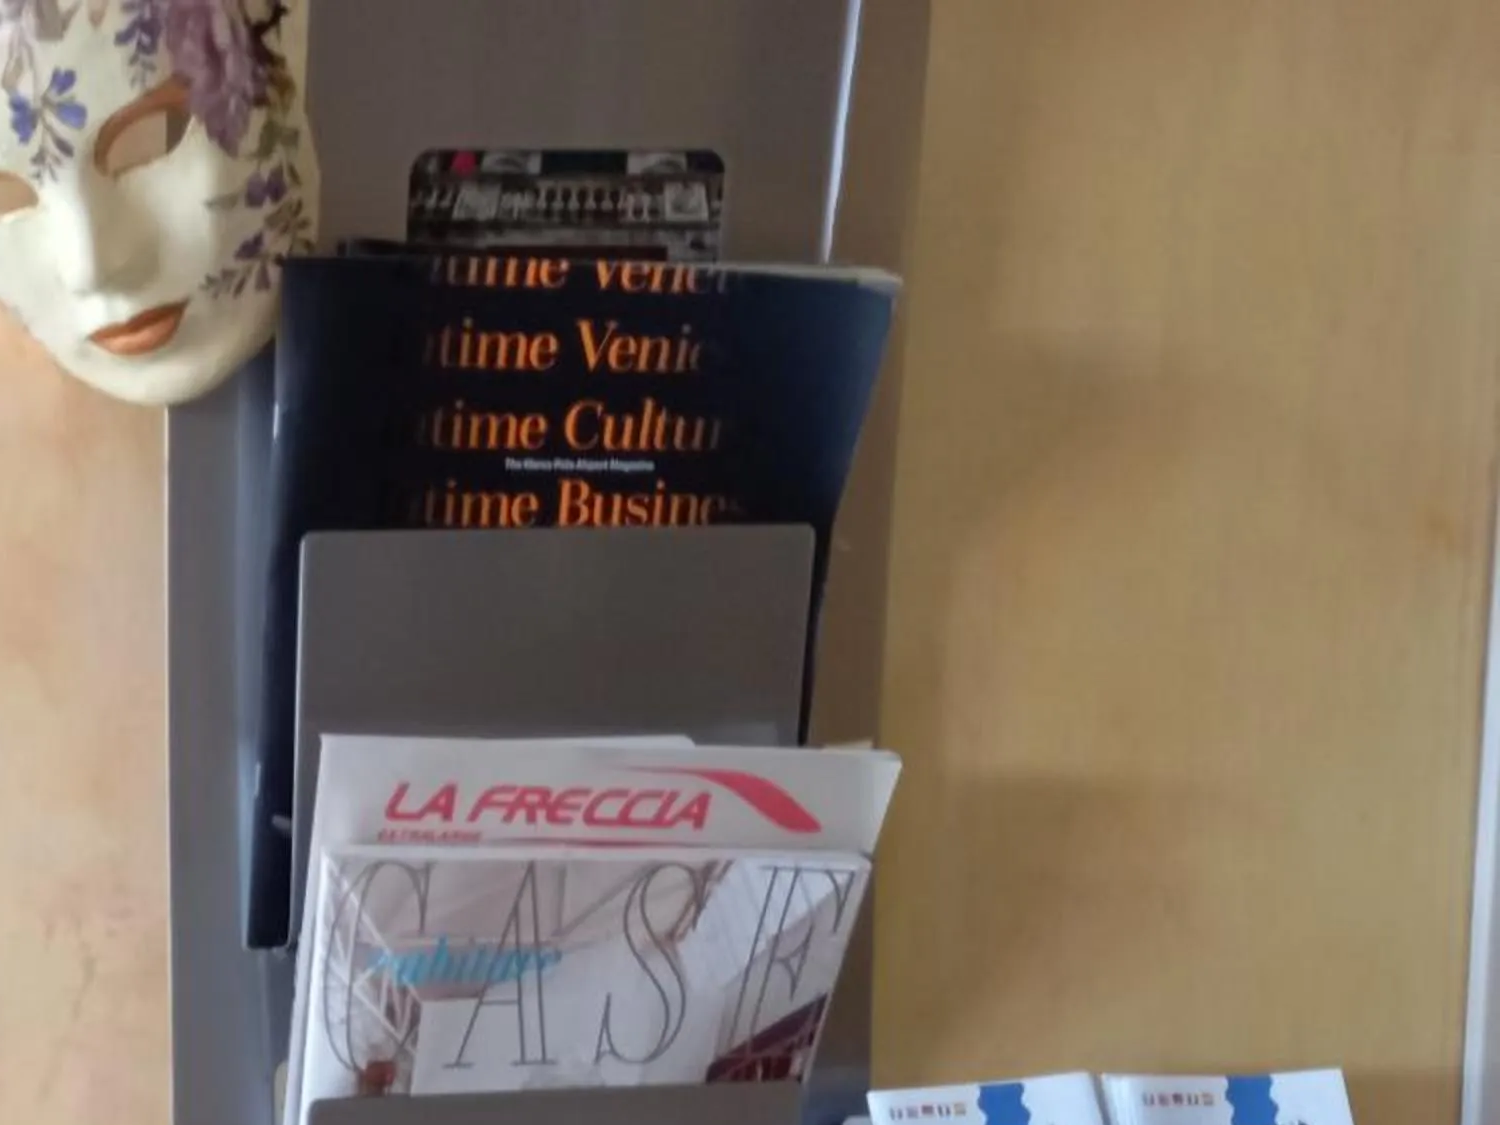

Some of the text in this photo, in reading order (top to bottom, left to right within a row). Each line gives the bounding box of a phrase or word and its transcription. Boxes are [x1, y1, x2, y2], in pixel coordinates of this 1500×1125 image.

[425, 316, 559, 370] time
[420, 399, 547, 449] time
[414, 480, 539, 527] time
[385, 782, 712, 831] LA FRECCIA
